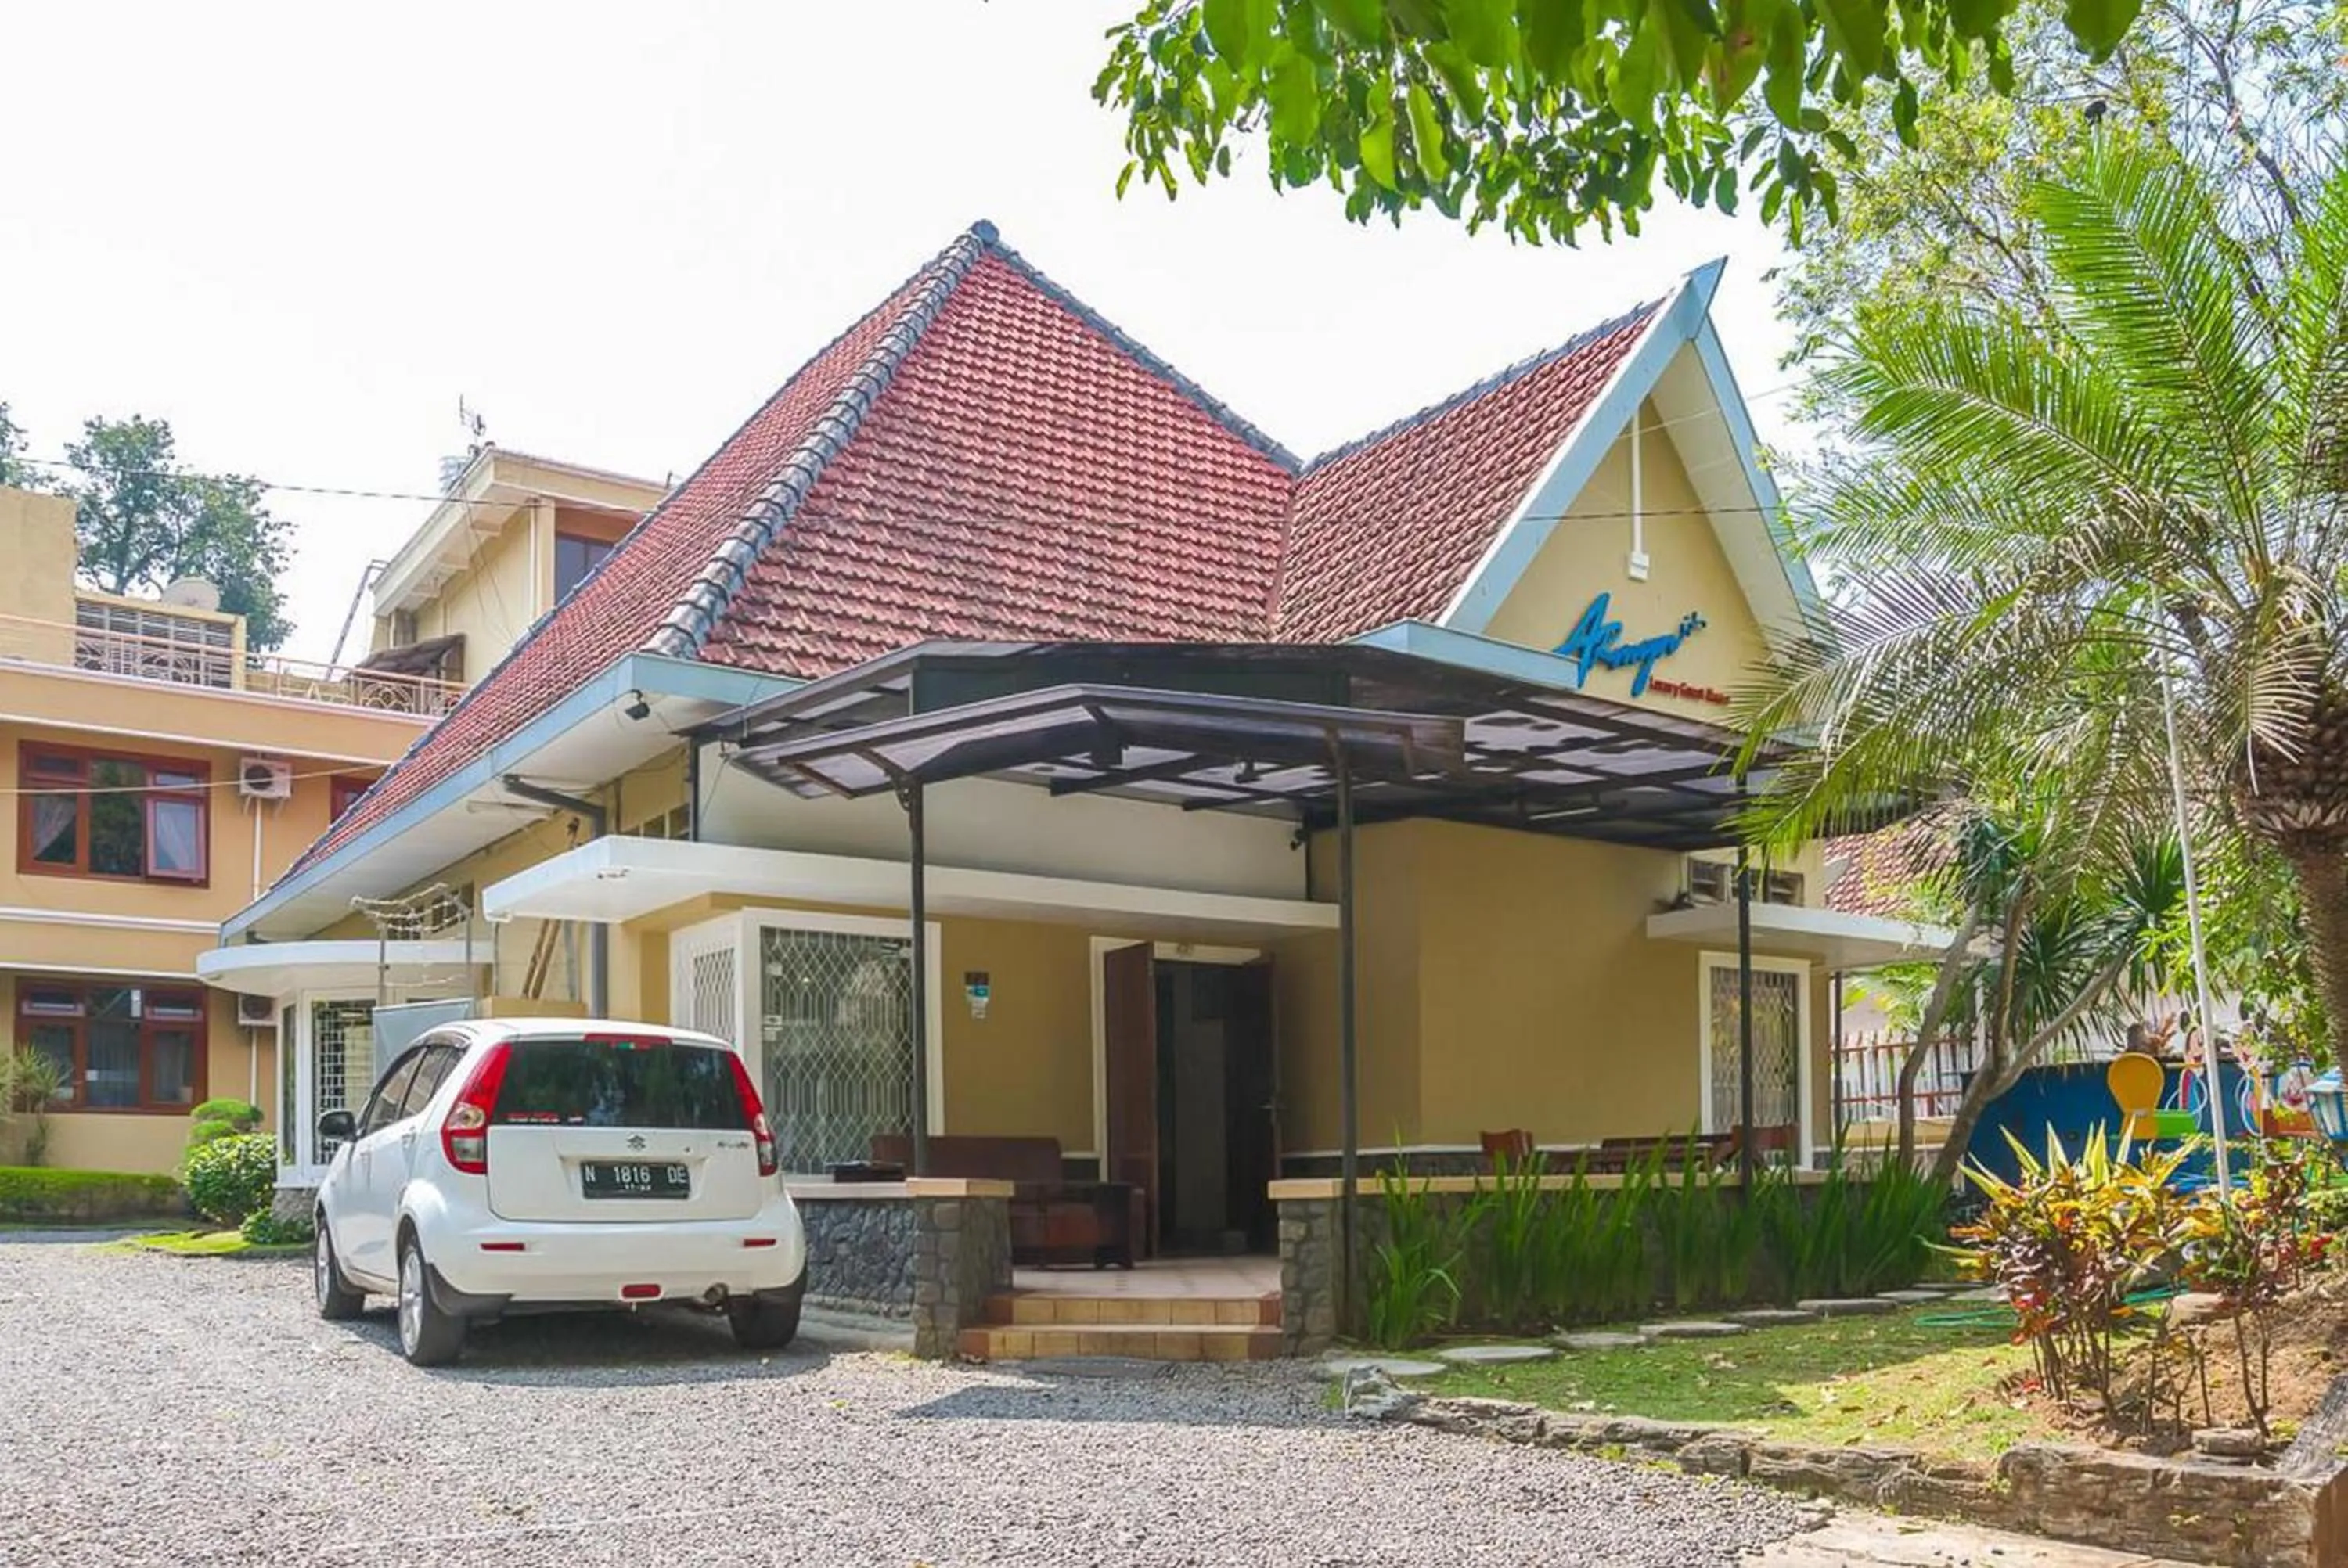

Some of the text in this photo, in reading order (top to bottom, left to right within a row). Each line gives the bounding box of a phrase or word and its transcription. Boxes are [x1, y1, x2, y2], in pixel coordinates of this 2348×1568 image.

[585, 1165, 687, 1184] N 1816 DE
